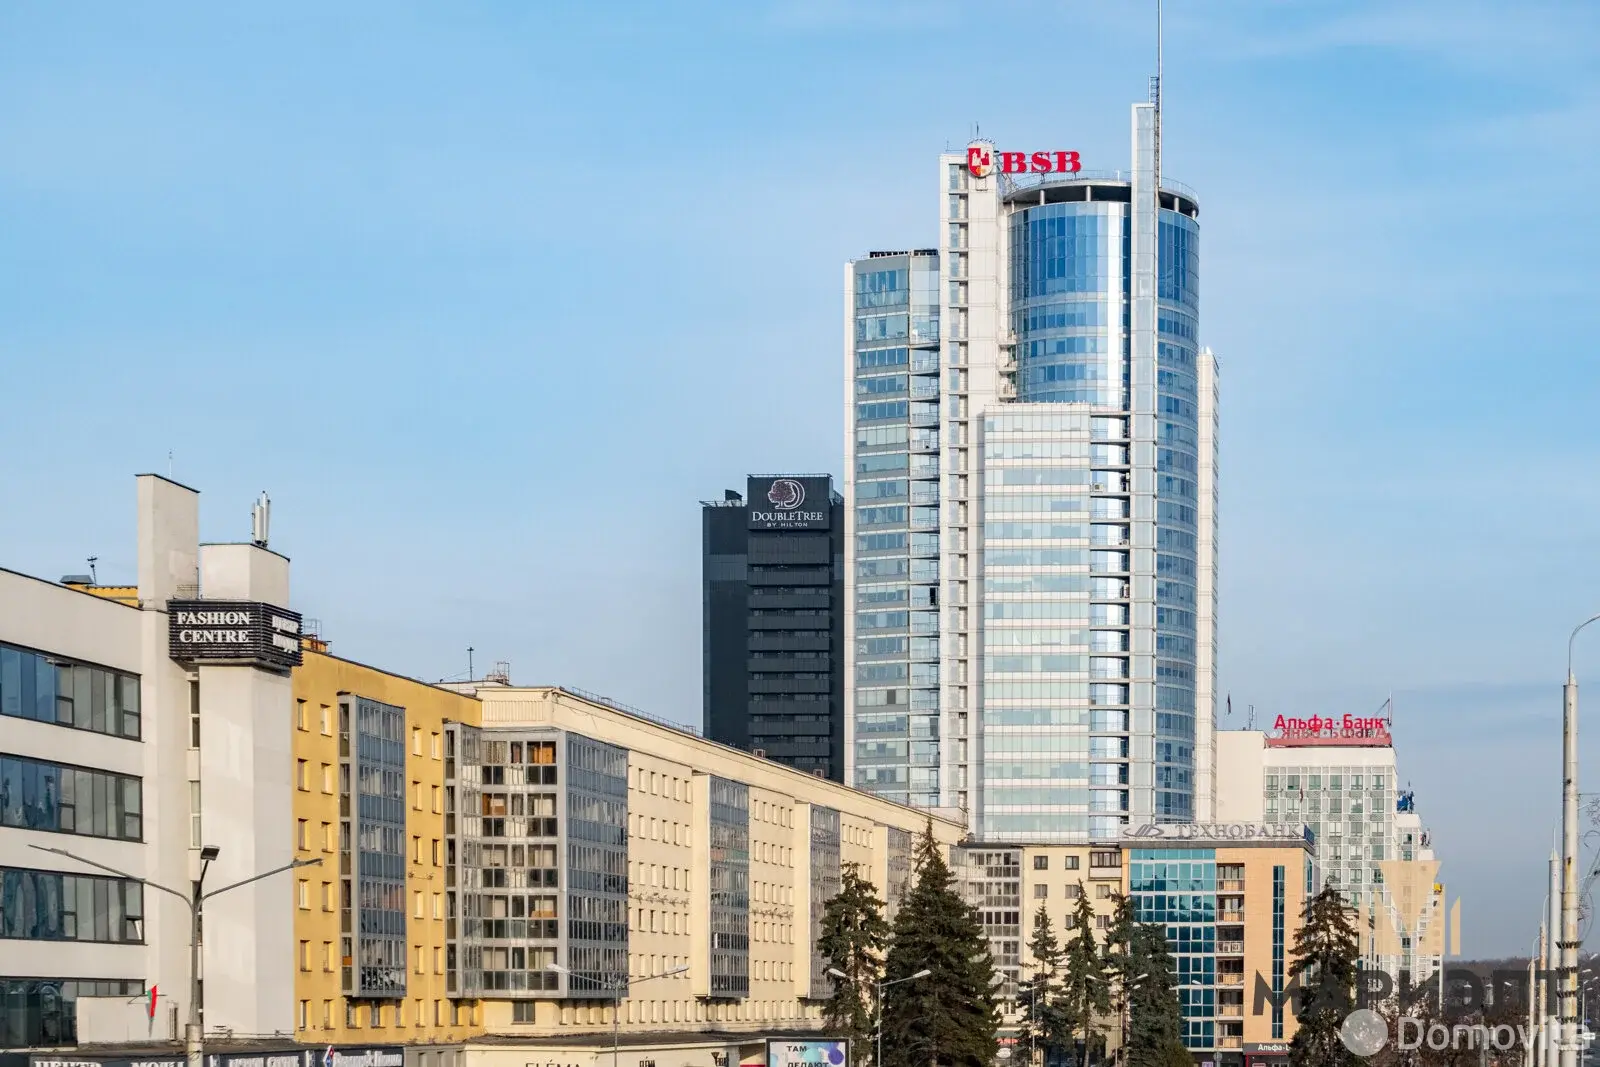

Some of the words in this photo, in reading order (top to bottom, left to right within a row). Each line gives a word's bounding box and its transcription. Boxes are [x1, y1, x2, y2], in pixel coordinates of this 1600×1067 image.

[1001, 151, 1082, 173] BSB
[176, 611, 250, 625] FASHION
[179, 629, 249, 643] CENTRE
[1175, 824, 1301, 839] ТЕХНОБАНК
